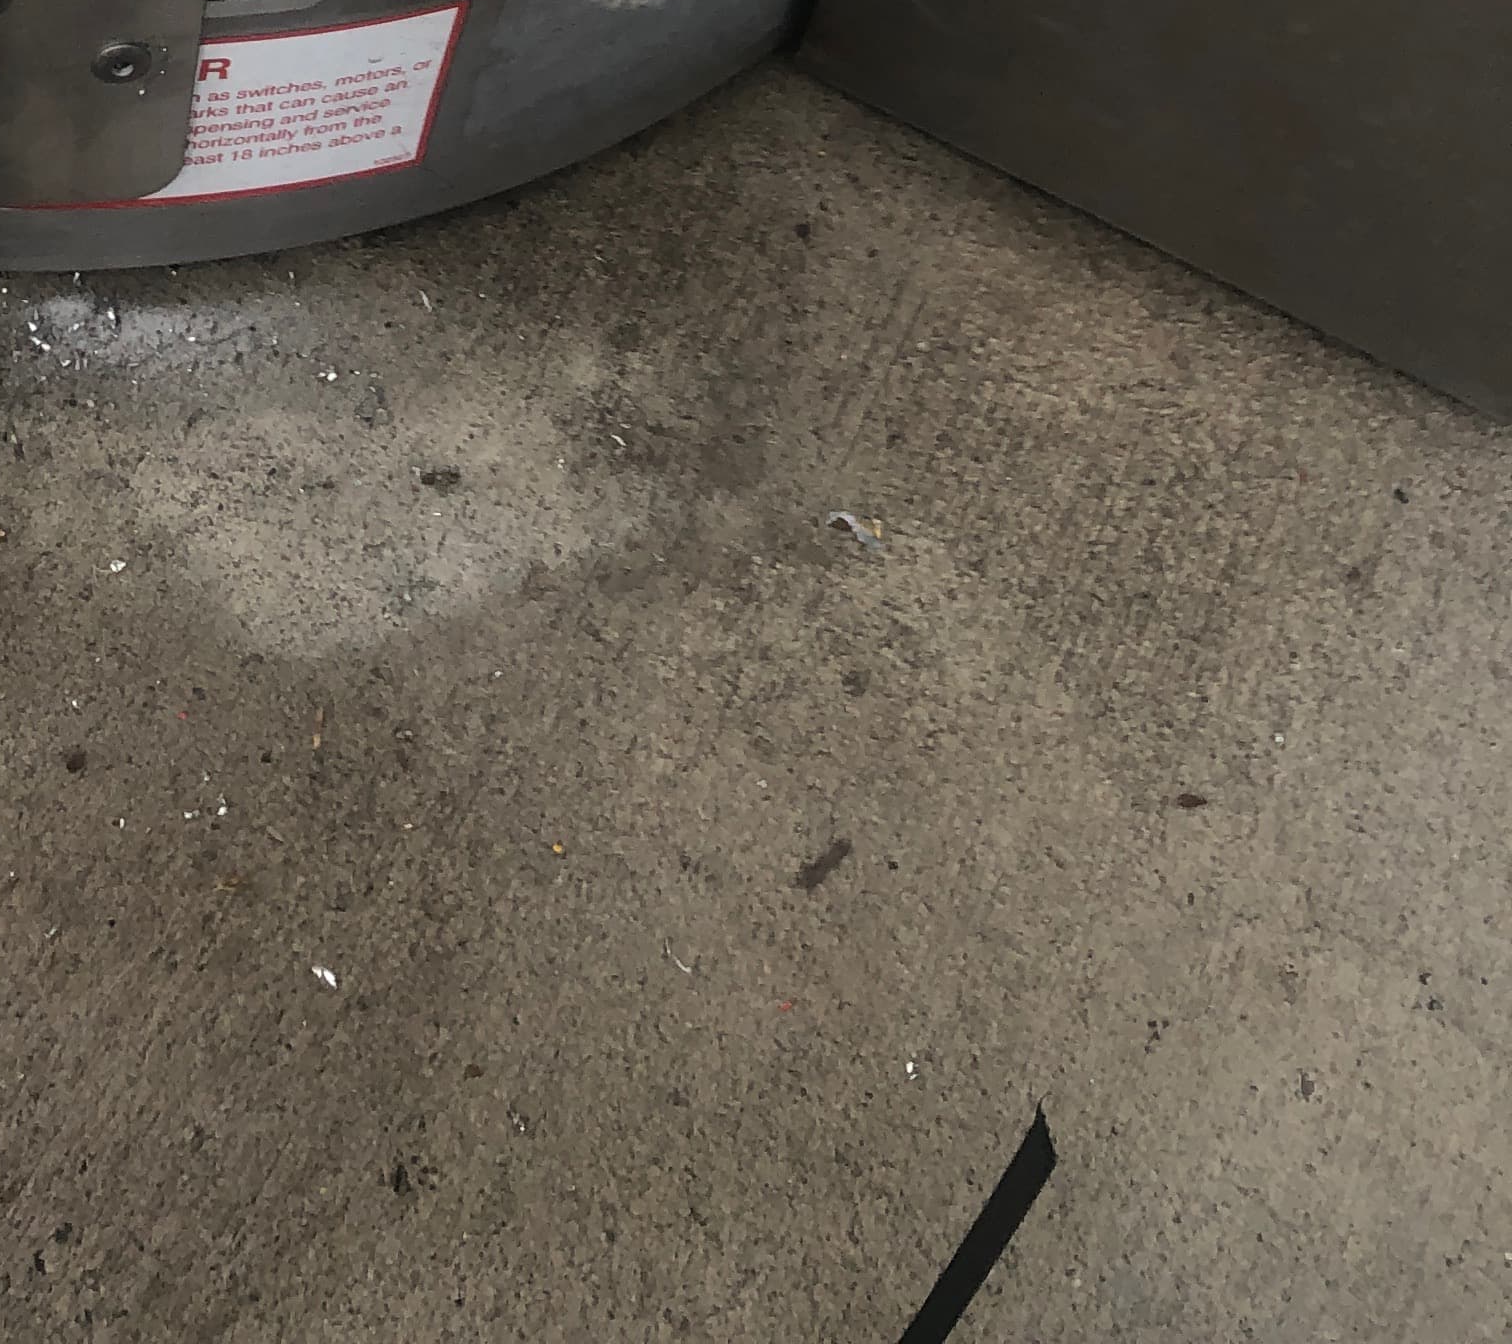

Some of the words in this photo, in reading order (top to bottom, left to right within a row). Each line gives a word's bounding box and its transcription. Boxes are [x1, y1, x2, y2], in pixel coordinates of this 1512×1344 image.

[207, 92, 230, 102] as
[412, 59, 433, 71] or
[236, 101, 274, 115] that
[279, 97, 316, 110] can
[321, 86, 379, 103] cause
[384, 80, 408, 92] an
[279, 109, 319, 125] and
[232, 149, 253, 161] 18
[259, 140, 322, 159] inches
